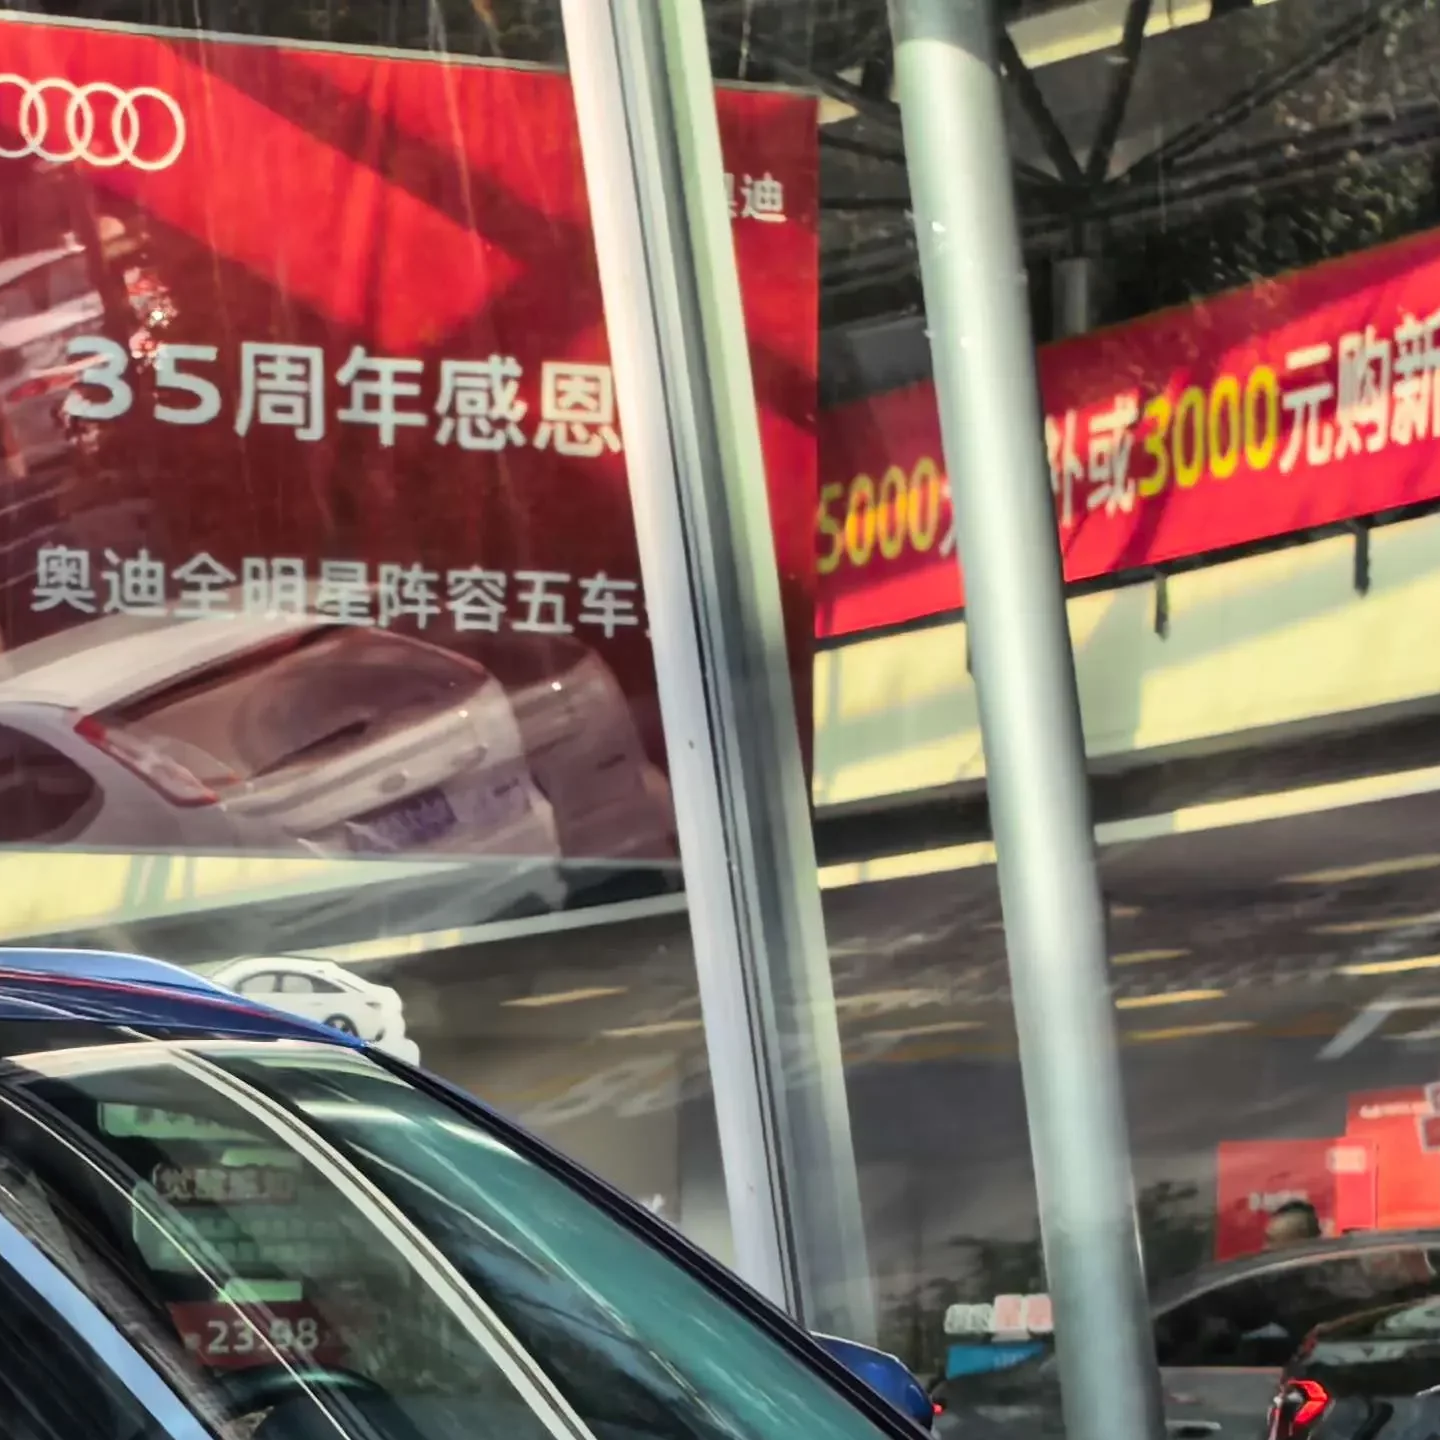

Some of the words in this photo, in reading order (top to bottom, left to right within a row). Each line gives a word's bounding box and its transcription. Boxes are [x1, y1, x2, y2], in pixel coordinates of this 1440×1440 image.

[62, 335, 622, 457] 35周年感恩
[30, 544, 651, 640] 奥迪全明星阵容五车
